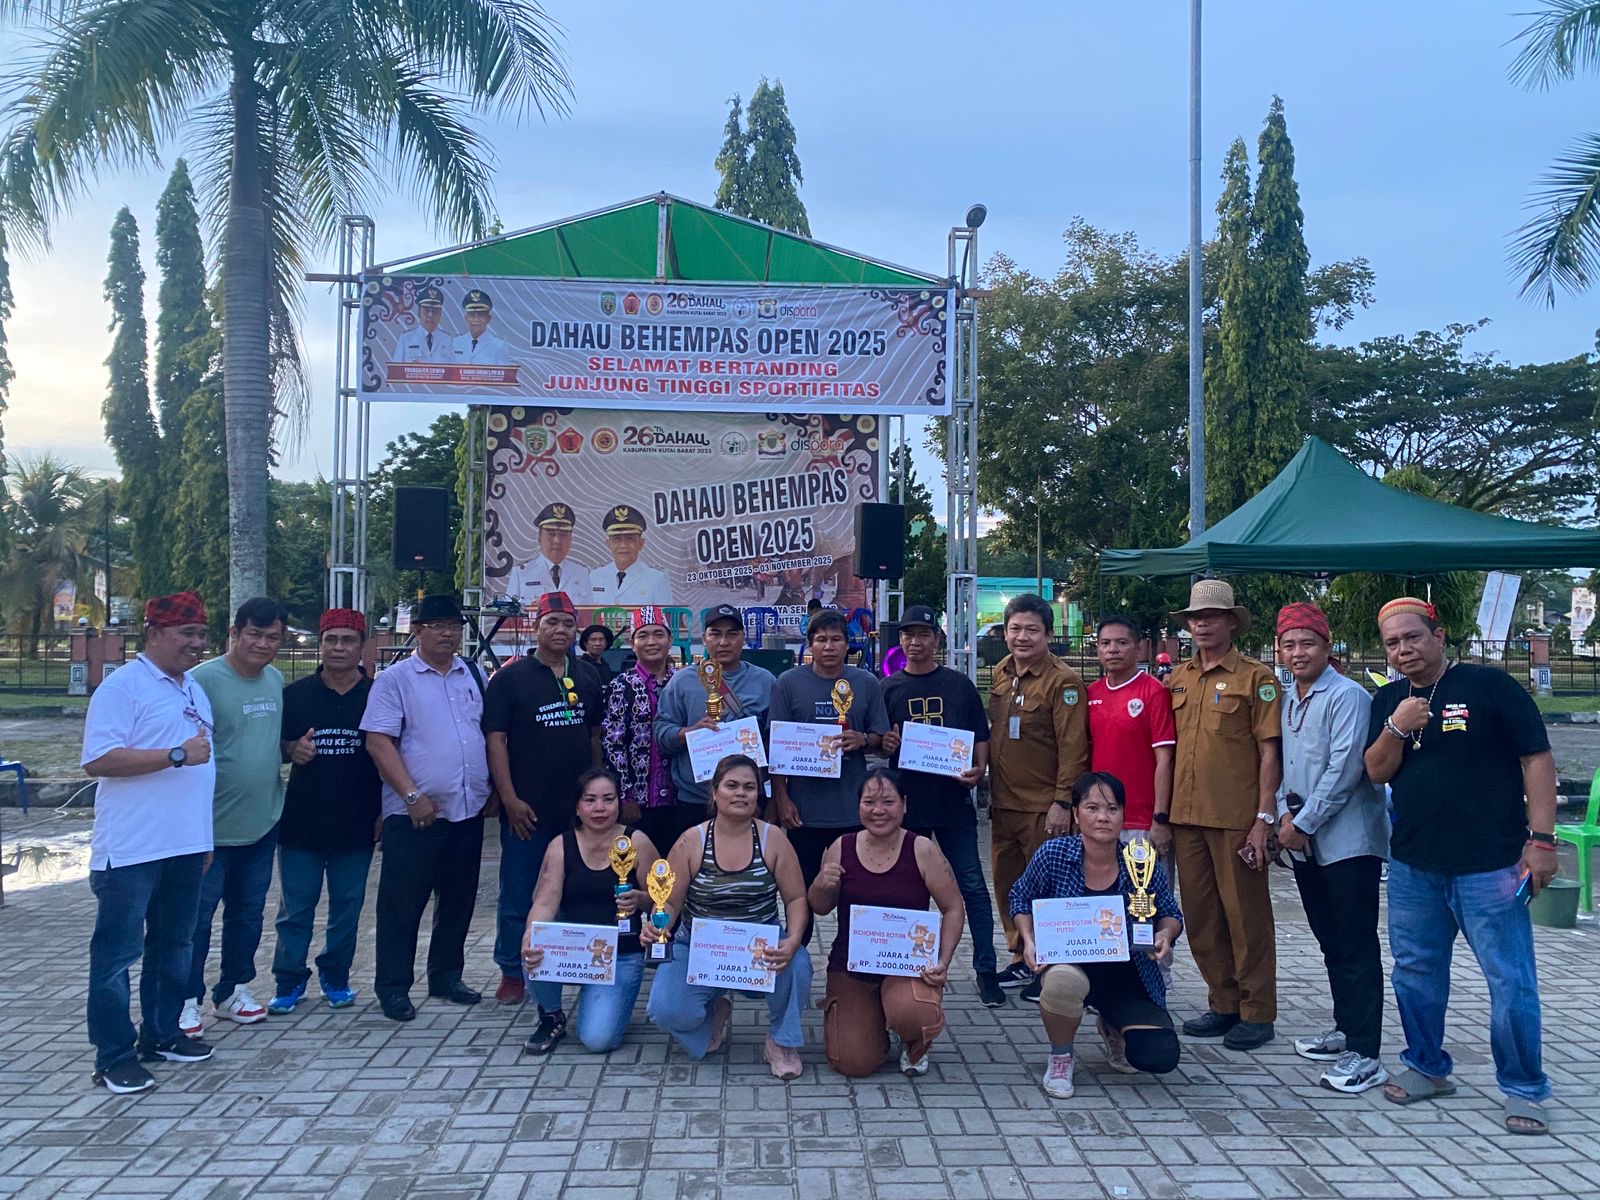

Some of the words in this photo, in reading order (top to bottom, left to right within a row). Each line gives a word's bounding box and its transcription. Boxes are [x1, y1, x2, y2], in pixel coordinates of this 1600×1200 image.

[667, 293, 688, 309] 26
[688, 297, 725, 309] DAHAU
[531, 321, 611, 350] DAHAU
[621, 324, 749, 354] BEHEMPAS
[758, 327, 819, 355] OPEN
[828, 329, 886, 357] 2025
[588, 356, 691, 373] SELAMAT
[699, 360, 838, 377] BERTANDING
[543, 376, 649, 393] JUNJUNG
[656, 378, 730, 394] TINGGI
[738, 381, 880, 398] SPORTIFITAS
[623, 425, 654, 446] 26
[654, 432, 710, 446] DAHAU
[653, 484, 726, 525] DAHAU
[732, 468, 848, 515] BEHEMPAS
[697, 523, 752, 563] OPEN
[760, 516, 814, 554] 2025
[687, 573, 697, 582] 23
[698, 568, 733, 580] OKTOBER
[734, 565, 753, 576] 2025
[759, 564, 770, 573] 03
[771, 560, 812, 571] NOVEMBER
[813, 555, 832, 566] 2025
[767, 617, 801, 626] CNTER
[536, 710, 565, 722] DAHAU
[544, 719, 569, 727] TAHUN
[922, 754, 943, 762] JUARA
[1066, 938, 1094, 946] JUARA
[877, 951, 903, 960] JUARA
[557, 962, 582, 970] JUARA
[716, 963, 742, 973] JUARA
[859, 960, 871, 968] RP.
[698, 973, 710, 981] RP.
